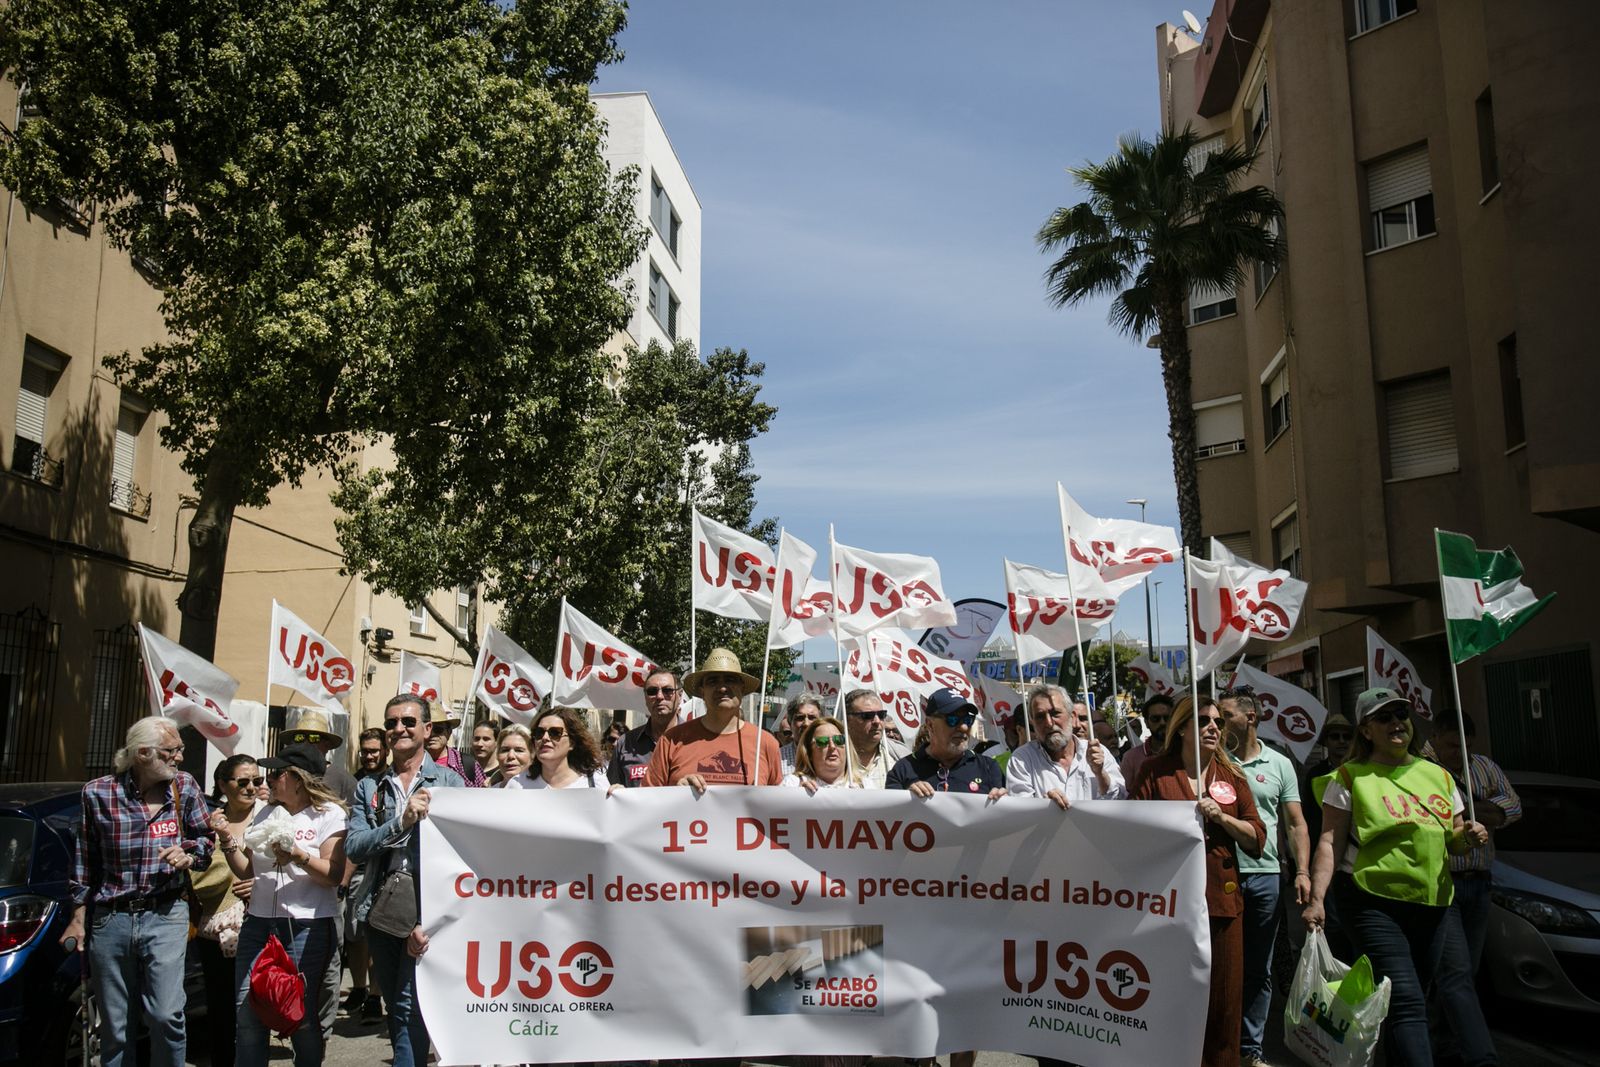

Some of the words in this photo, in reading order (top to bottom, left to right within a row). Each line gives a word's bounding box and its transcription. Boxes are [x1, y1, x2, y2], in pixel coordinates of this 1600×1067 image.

[836, 562, 942, 618] USO
[1007, 592, 1117, 634] USO
[280, 626, 355, 694] USO
[986, 663, 1006, 679] DE
[1382, 794, 1452, 819] USO
[152, 821, 177, 834] USO
[662, 819, 708, 852] 1º
[736, 817, 790, 850] DE
[806, 819, 935, 853] MAYO
[454, 872, 557, 899] Contra
[568, 874, 594, 900] el
[604, 873, 780, 907] desempleo
[790, 879, 809, 905] y
[820, 871, 846, 898] la
[858, 874, 1050, 905] precariedad
[1063, 880, 1177, 918] laboral
[466, 941, 614, 999] USO
[815, 974, 877, 992] ACABÓ
[1003, 939, 1151, 1012] USO
[466, 1000, 508, 1013] UNIÓN
[512, 1002, 565, 1013] SINDICAL
[569, 1001, 614, 1012] OBRERA
[802, 995, 815, 1006] EL
[819, 992, 878, 1008] JUEGO
[1002, 995, 1043, 1008] UNIÓN
[1047, 1000, 1100, 1019] SINDICAL
[1103, 1011, 1148, 1031] OBRERA
[509, 1019, 559, 1036] Cádiz
